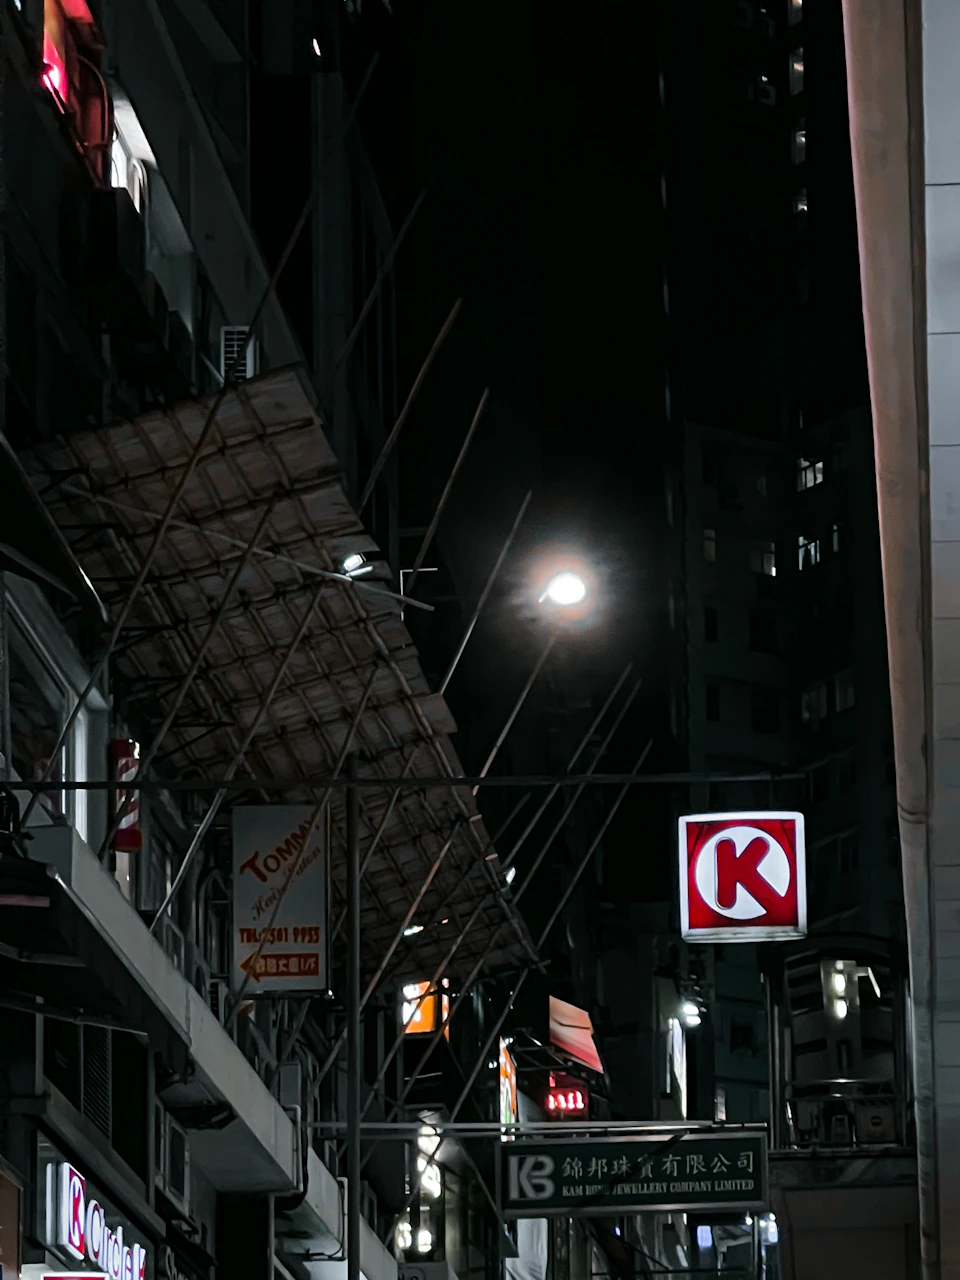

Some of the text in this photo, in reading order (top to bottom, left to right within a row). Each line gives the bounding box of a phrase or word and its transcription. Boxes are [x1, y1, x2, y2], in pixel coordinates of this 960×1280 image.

[715, 837, 787, 916] K
[562, 1184, 583, 1197] KAM
[670, 1180, 713, 1194] COMPANY
[714, 1179, 755, 1192] LIMITED
